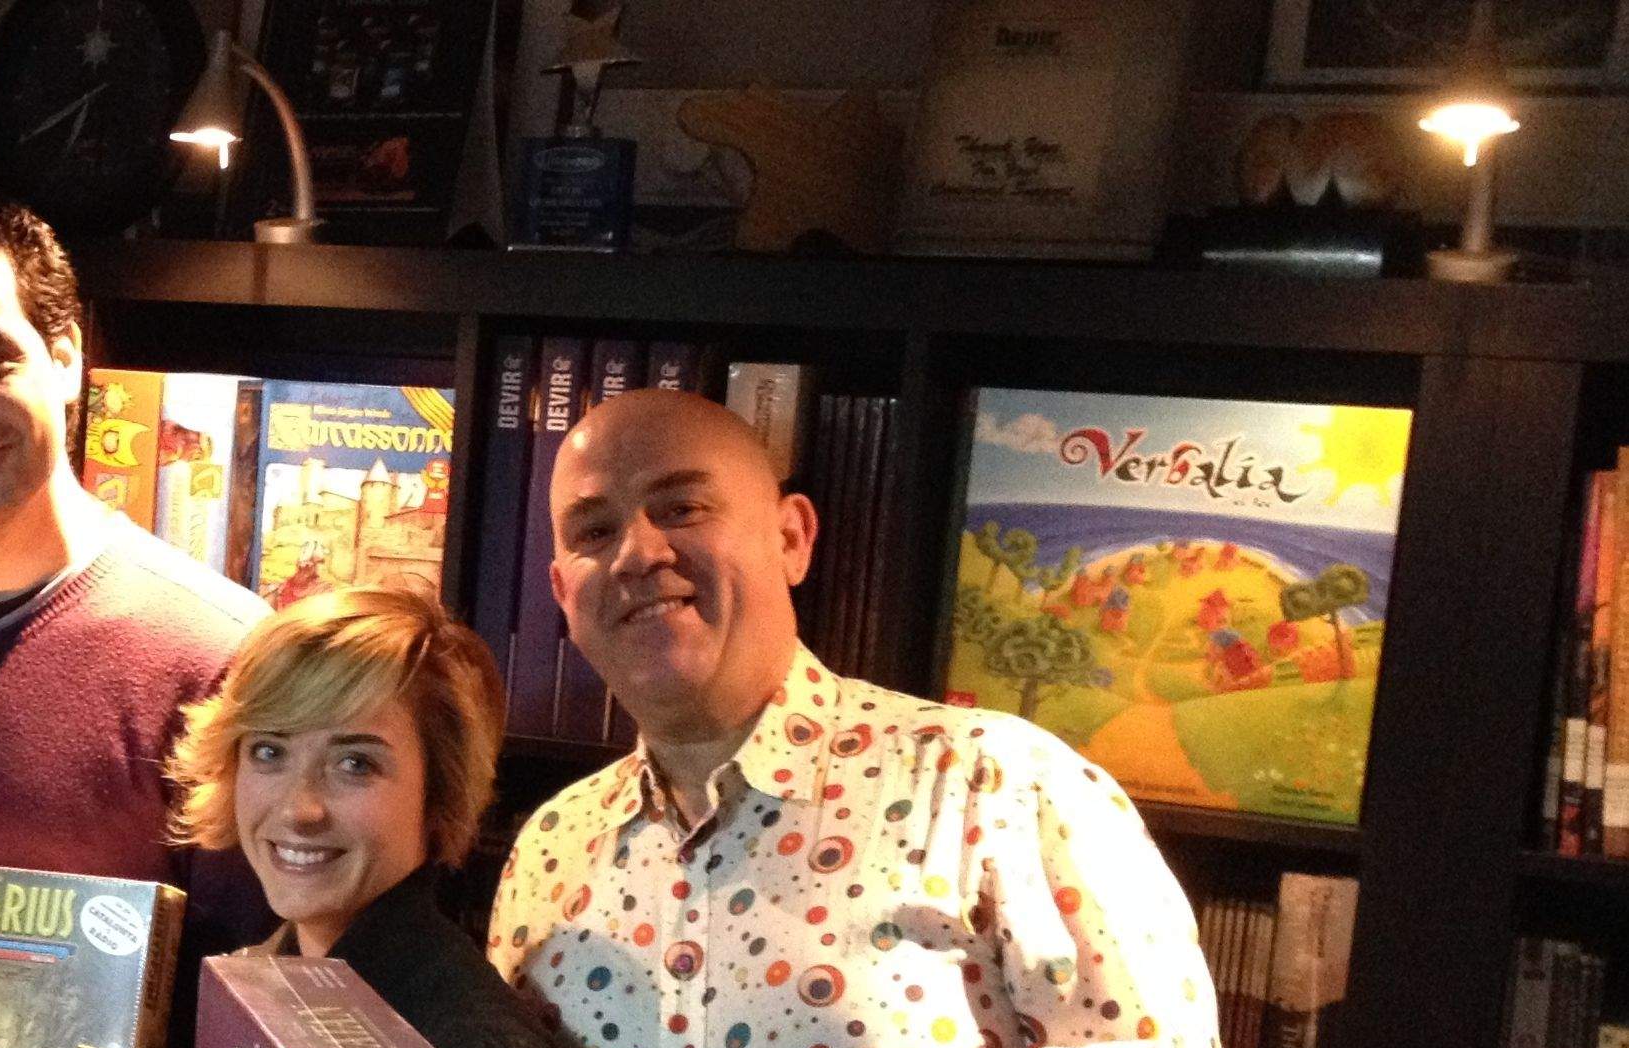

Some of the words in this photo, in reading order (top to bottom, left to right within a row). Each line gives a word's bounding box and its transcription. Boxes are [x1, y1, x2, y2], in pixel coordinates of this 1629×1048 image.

[498, 371, 521, 429] DEVIR
[547, 373, 572, 431] DEVIR
[1060, 428, 1308, 503] Verbalia
